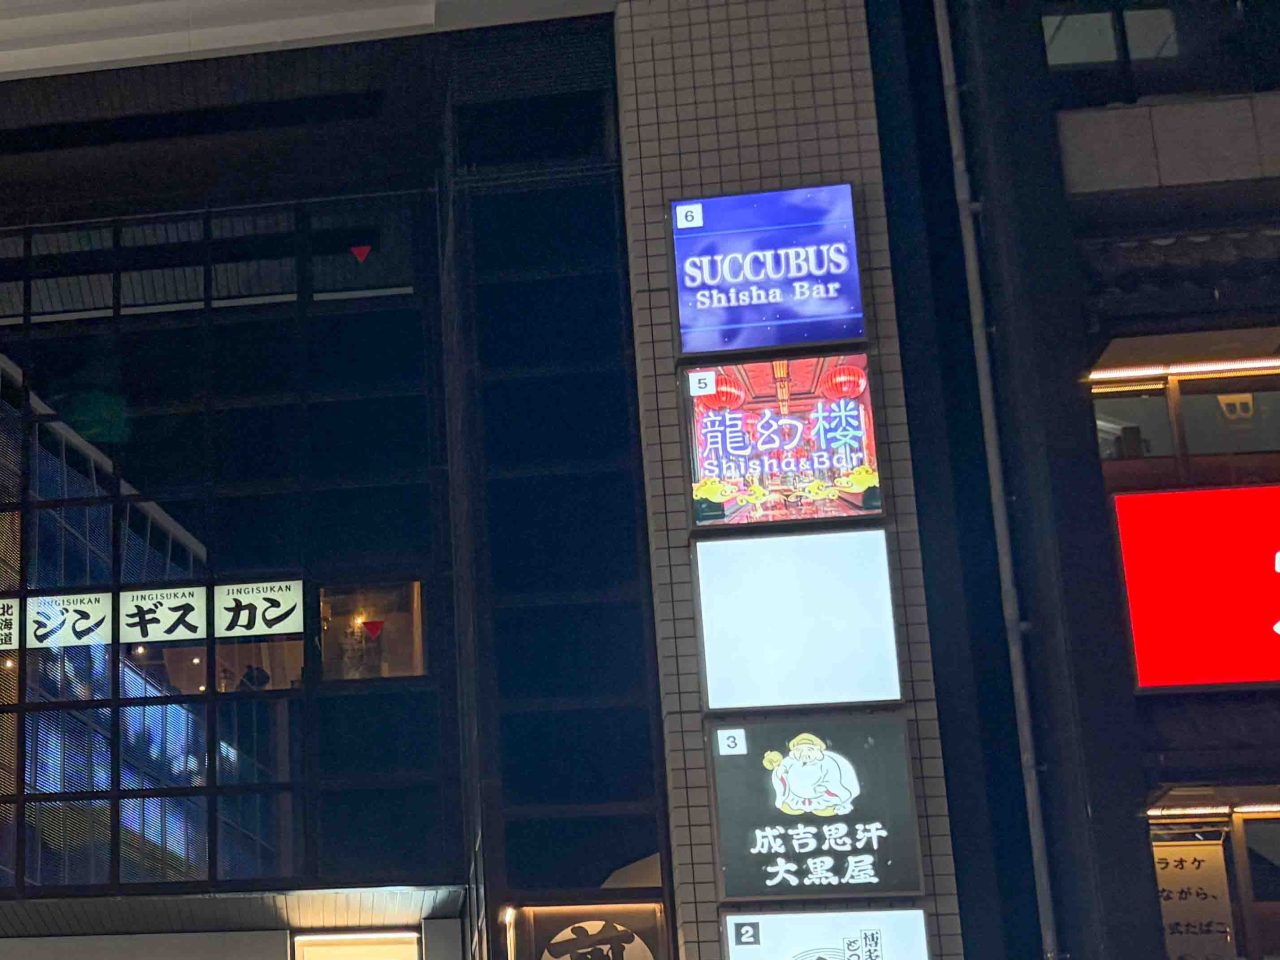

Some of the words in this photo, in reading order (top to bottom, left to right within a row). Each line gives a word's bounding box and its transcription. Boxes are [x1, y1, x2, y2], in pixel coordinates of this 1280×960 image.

[684, 211, 695, 223] 6
[683, 243, 850, 289] SUCCUBUS
[695, 285, 782, 310] Shisha
[793, 281, 841, 301] Bar
[697, 378, 708, 390] 5
[702, 400, 864, 456] 龍幻楼
[131, 591, 195, 602] JINGISUKAN
[226, 585, 291, 596] JINGISUKAN
[0, 603, 13, 646] 北海道
[726, 736, 738, 749] 3
[750, 822, 889, 854] 成吉思汗
[766, 855, 880, 887] 大黒屋
[740, 926, 755, 943] 2
